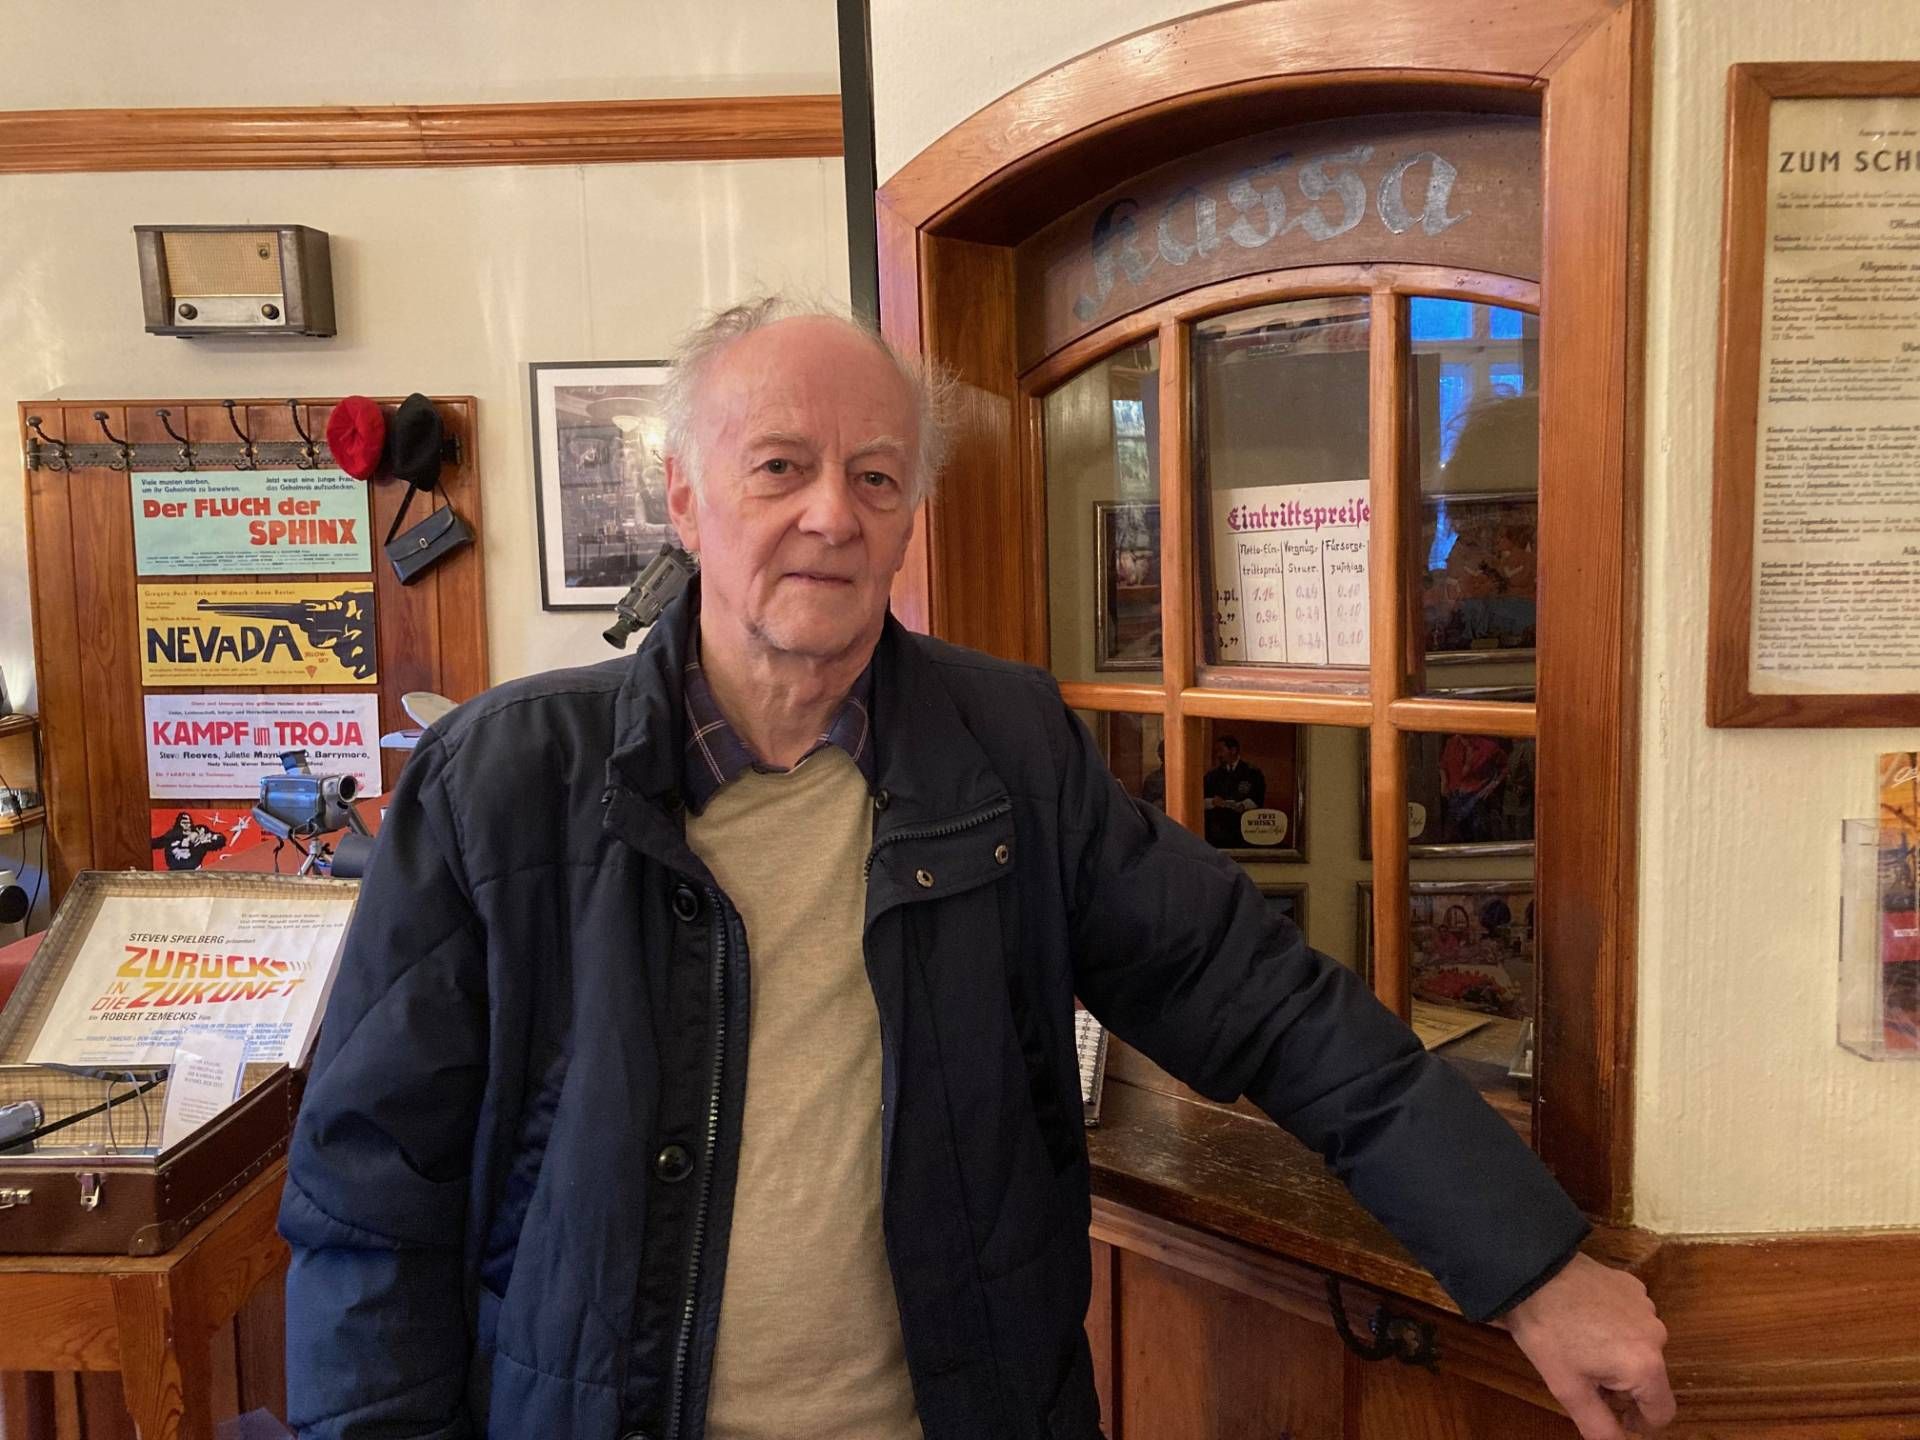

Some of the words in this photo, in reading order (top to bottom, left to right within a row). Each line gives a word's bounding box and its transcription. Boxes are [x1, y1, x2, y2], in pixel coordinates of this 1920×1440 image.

[1779, 150, 1840, 173] ZUM
[1073, 145, 1472, 322] Kassa
[143, 499, 187, 518] Der
[194, 497, 272, 518] FLUCH
[277, 497, 320, 516] der
[249, 519, 358, 545] SPHINX
[147, 625, 304, 664] NEVADA
[153, 721, 249, 746] KAMPF
[254, 727, 271, 746] um
[274, 720, 363, 746] TROJA
[183, 751, 221, 761] Reeves,
[224, 751, 251, 759] Juliette
[315, 751, 371, 762] Barrymore,
[128, 933, 167, 944] STEVEN
[170, 934, 225, 945] SPIELBERG
[116, 946, 284, 979] ZURÜCK
[90, 996, 129, 1011] DIE
[105, 982, 129, 994] IN
[126, 979, 304, 1009] ZUKUNFT
[100, 1012, 144, 1021] ROBERT
[144, 1012, 198, 1021] ZEMECKIS
